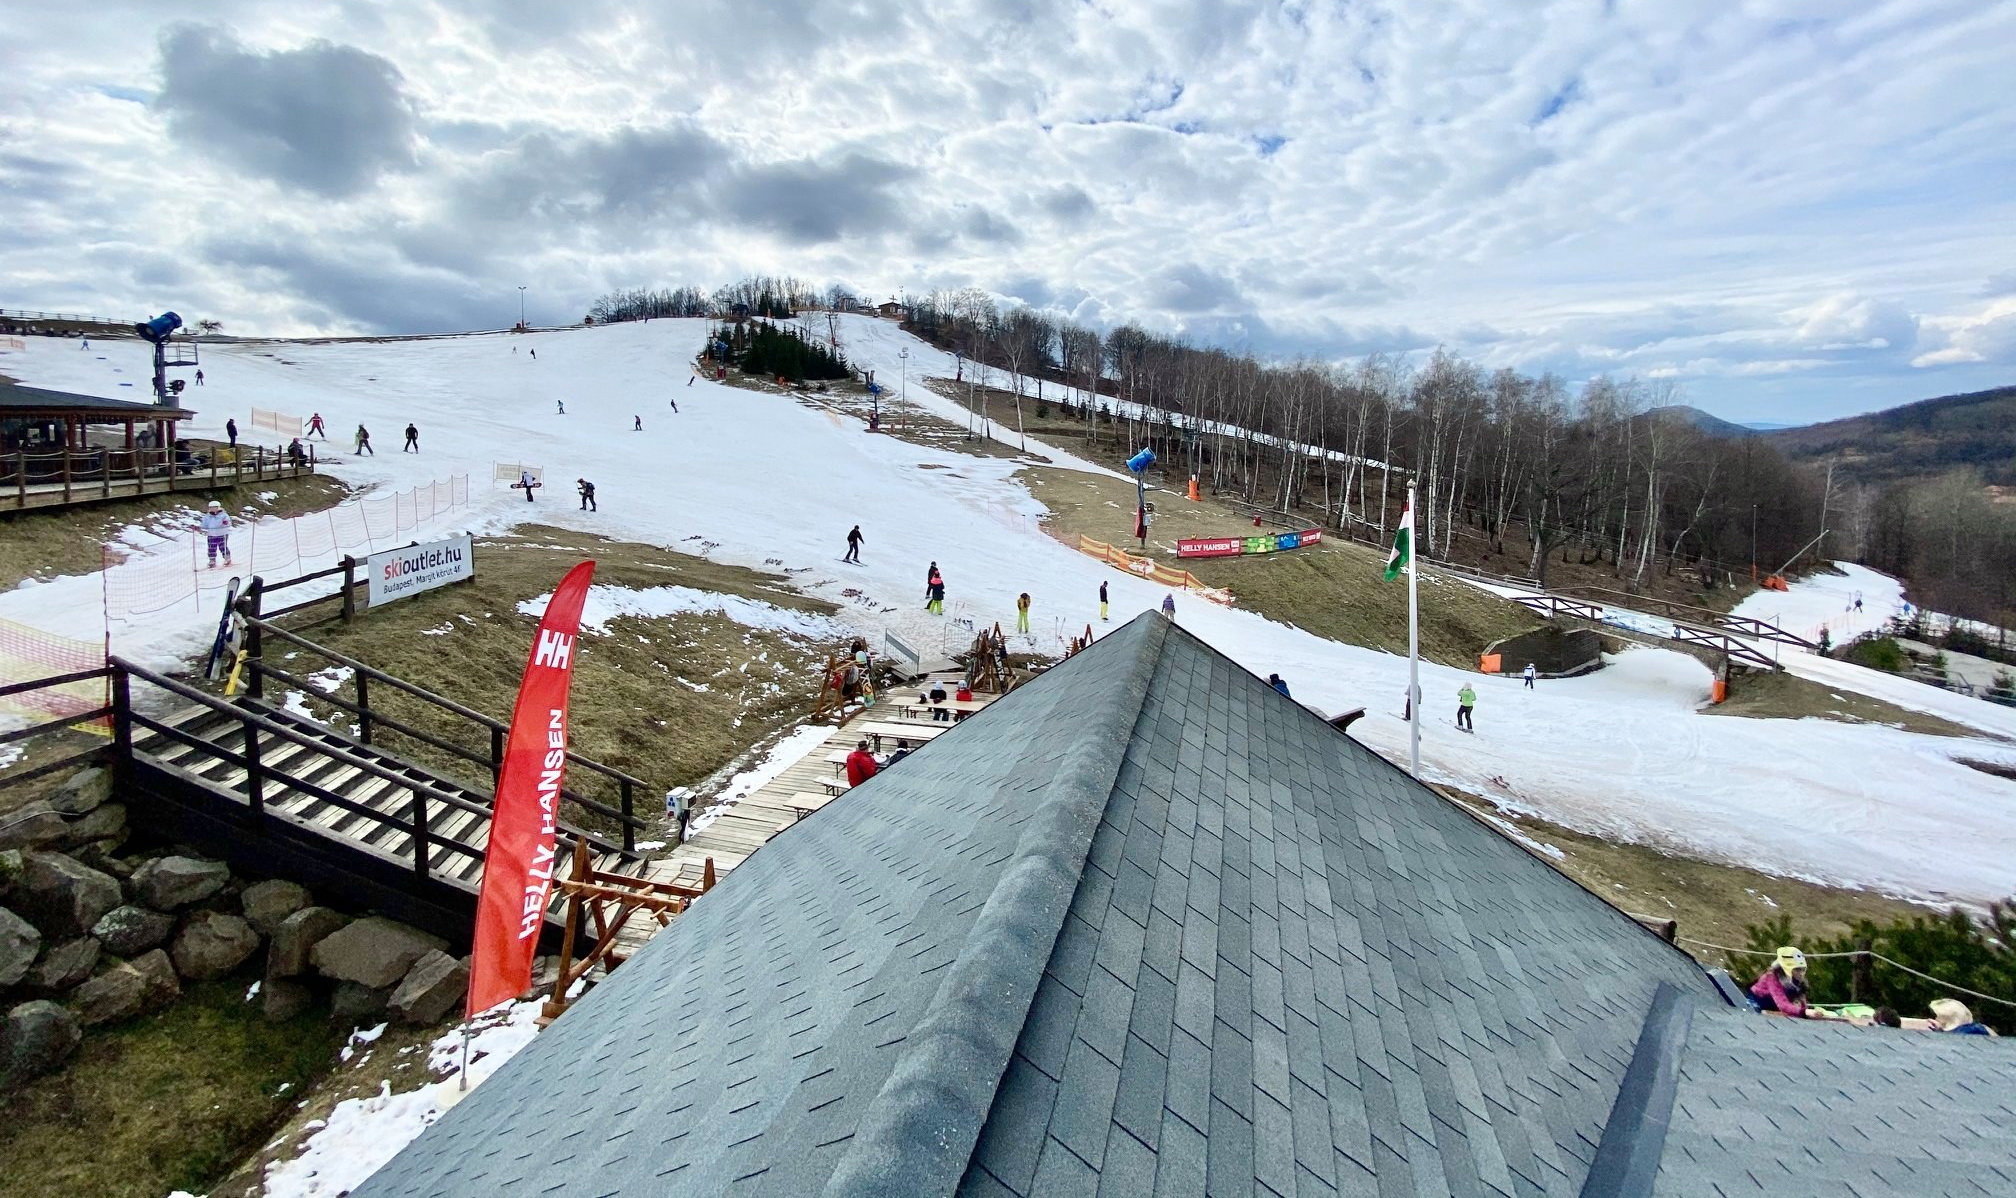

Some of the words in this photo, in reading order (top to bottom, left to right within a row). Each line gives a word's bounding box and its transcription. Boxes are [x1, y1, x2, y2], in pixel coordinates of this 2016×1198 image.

[1180, 544, 1202, 552] HELLY
[1203, 543, 1230, 551] HANSEN
[384, 546, 462, 581] skioutlet.hu
[416, 573, 436, 584] Margit
[518, 845, 554, 940] HELLY
[538, 708, 563, 835] HANSEN
